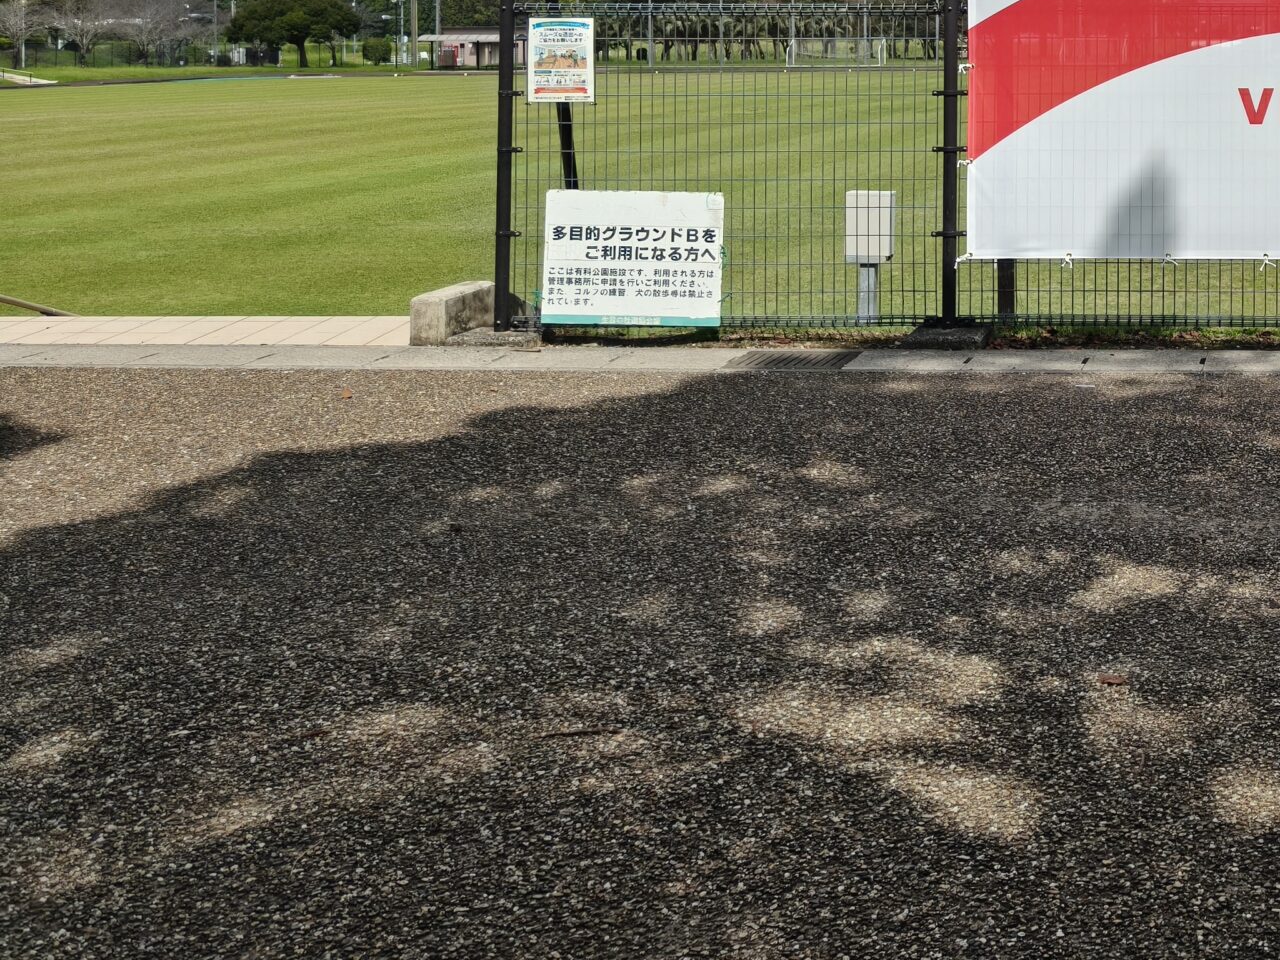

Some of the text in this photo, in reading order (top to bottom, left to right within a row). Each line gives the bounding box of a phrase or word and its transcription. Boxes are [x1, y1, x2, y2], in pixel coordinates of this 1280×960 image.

[552, 226, 717, 244] 多目的グラウンドBを
[585, 245, 716, 262] ご利用になる方へ
[547, 297, 594, 307] れています。
